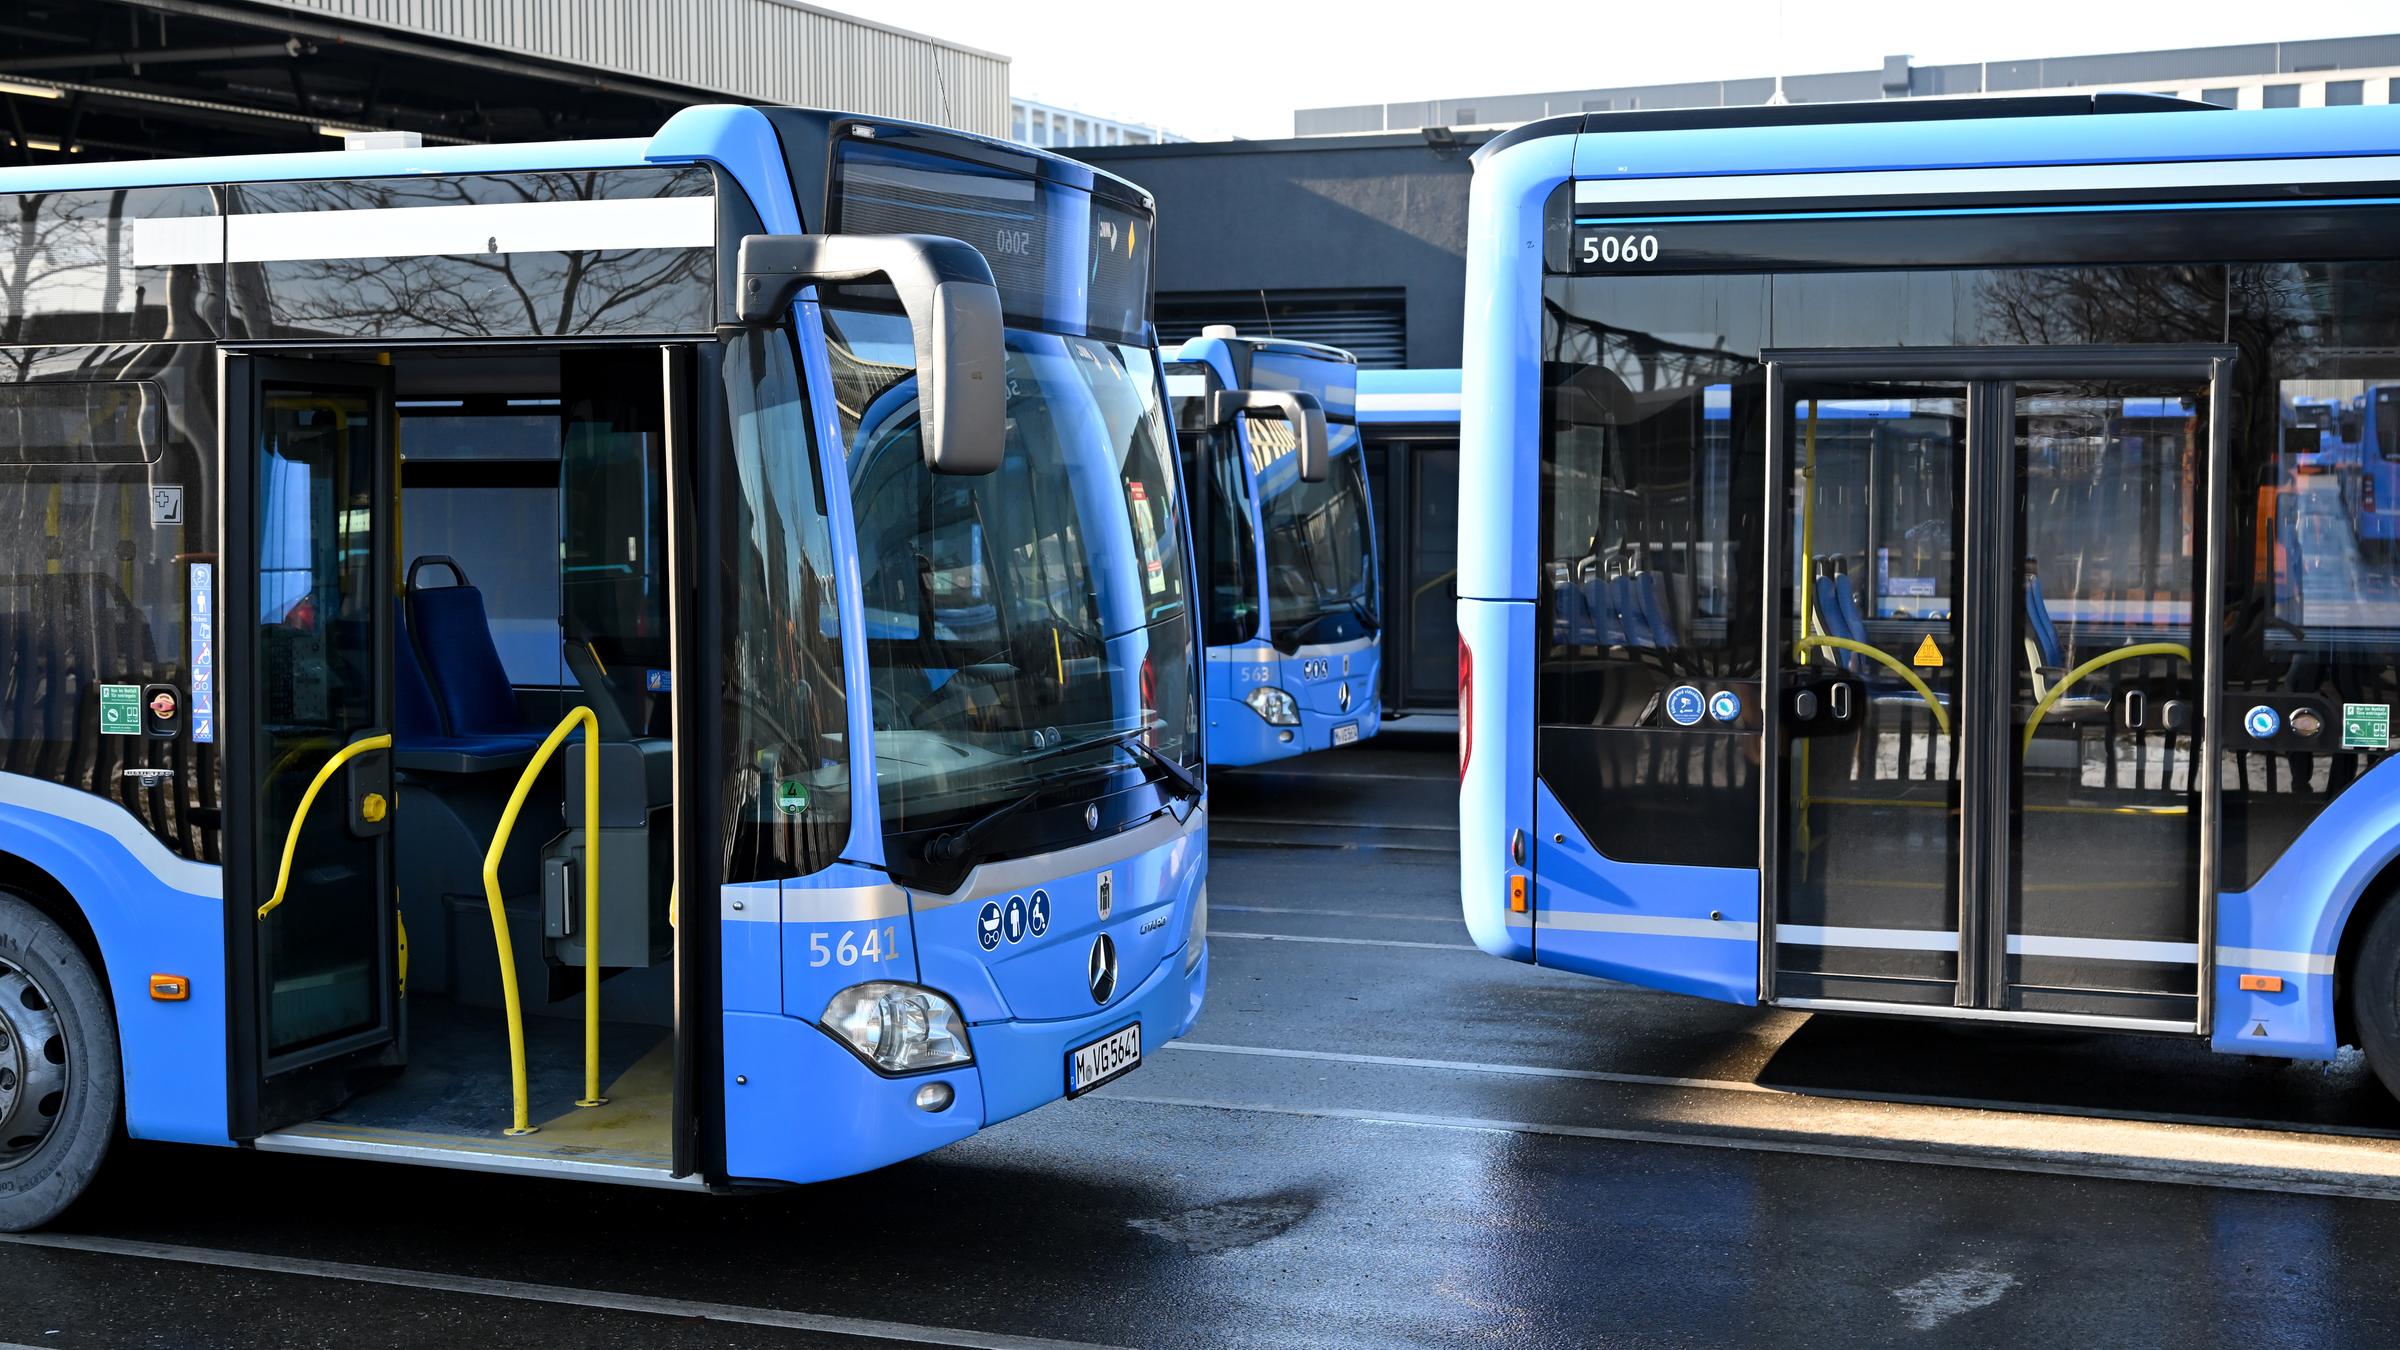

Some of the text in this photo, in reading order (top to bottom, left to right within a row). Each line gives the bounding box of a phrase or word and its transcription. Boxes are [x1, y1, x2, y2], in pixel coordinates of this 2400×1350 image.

[1583, 235, 1659, 263] 5060
[787, 782, 798, 797] 4
[810, 926, 899, 967] 5641
[1076, 1053, 1086, 1084] M
